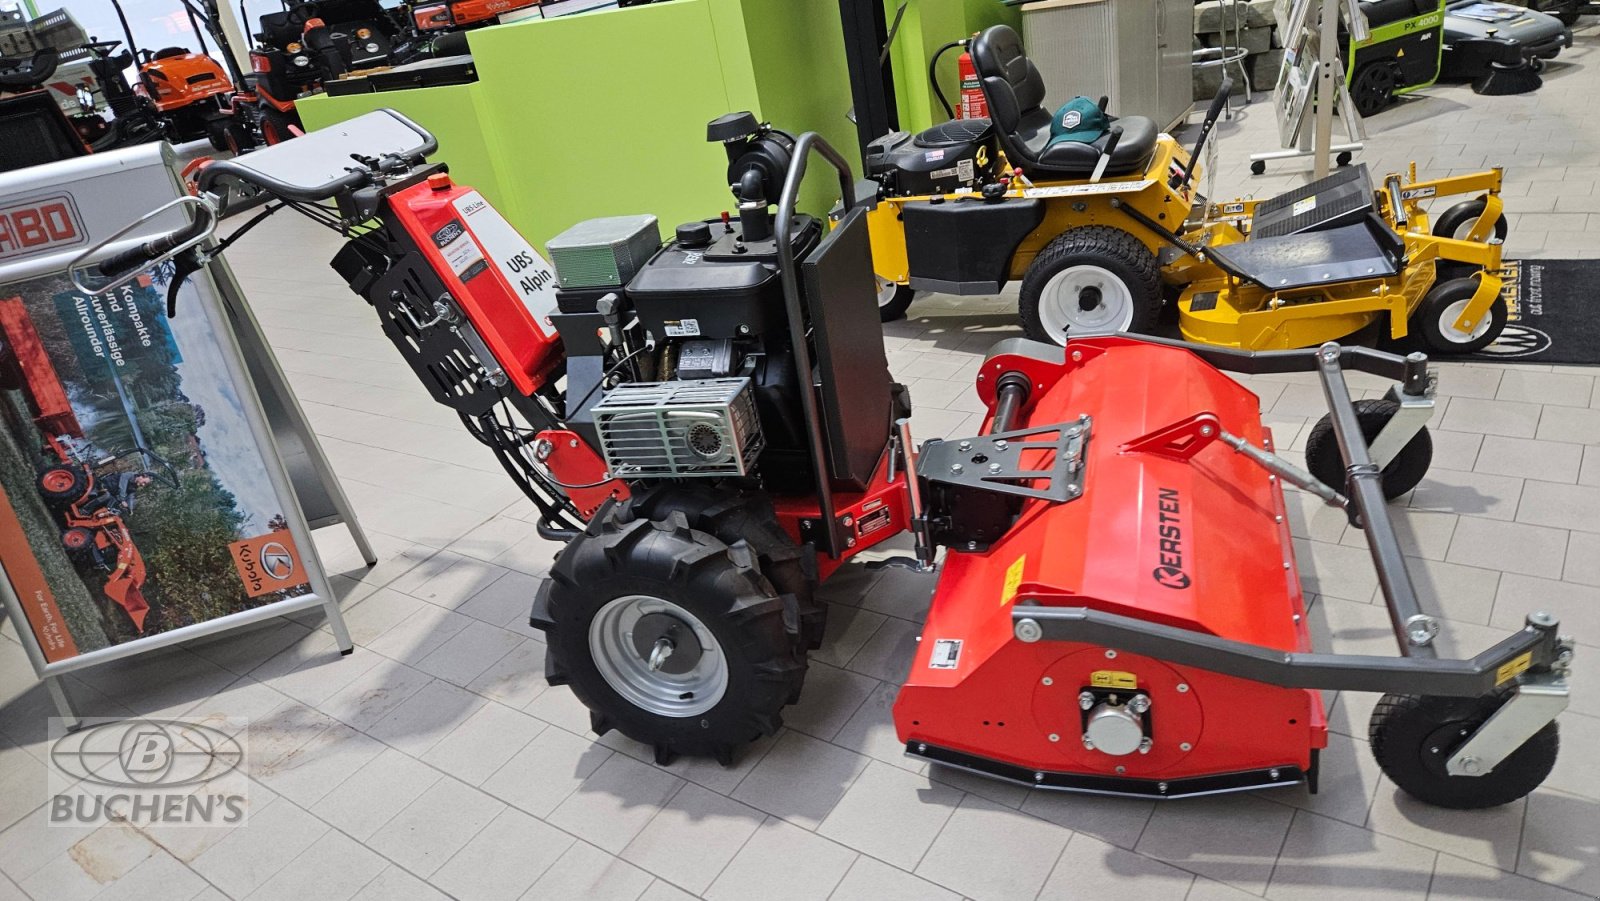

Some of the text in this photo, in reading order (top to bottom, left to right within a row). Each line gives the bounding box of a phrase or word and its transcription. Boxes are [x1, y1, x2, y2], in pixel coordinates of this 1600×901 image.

[1404, 15, 1438, 30] PX 4000
[506, 250, 533, 273] UBS
[519, 269, 552, 296] Alpin
[72, 296, 105, 358] Allrounder
[120, 285, 151, 347] Kompakte
[1152, 487, 1191, 590] KERSTEN
[239, 544, 263, 592] Kubota
